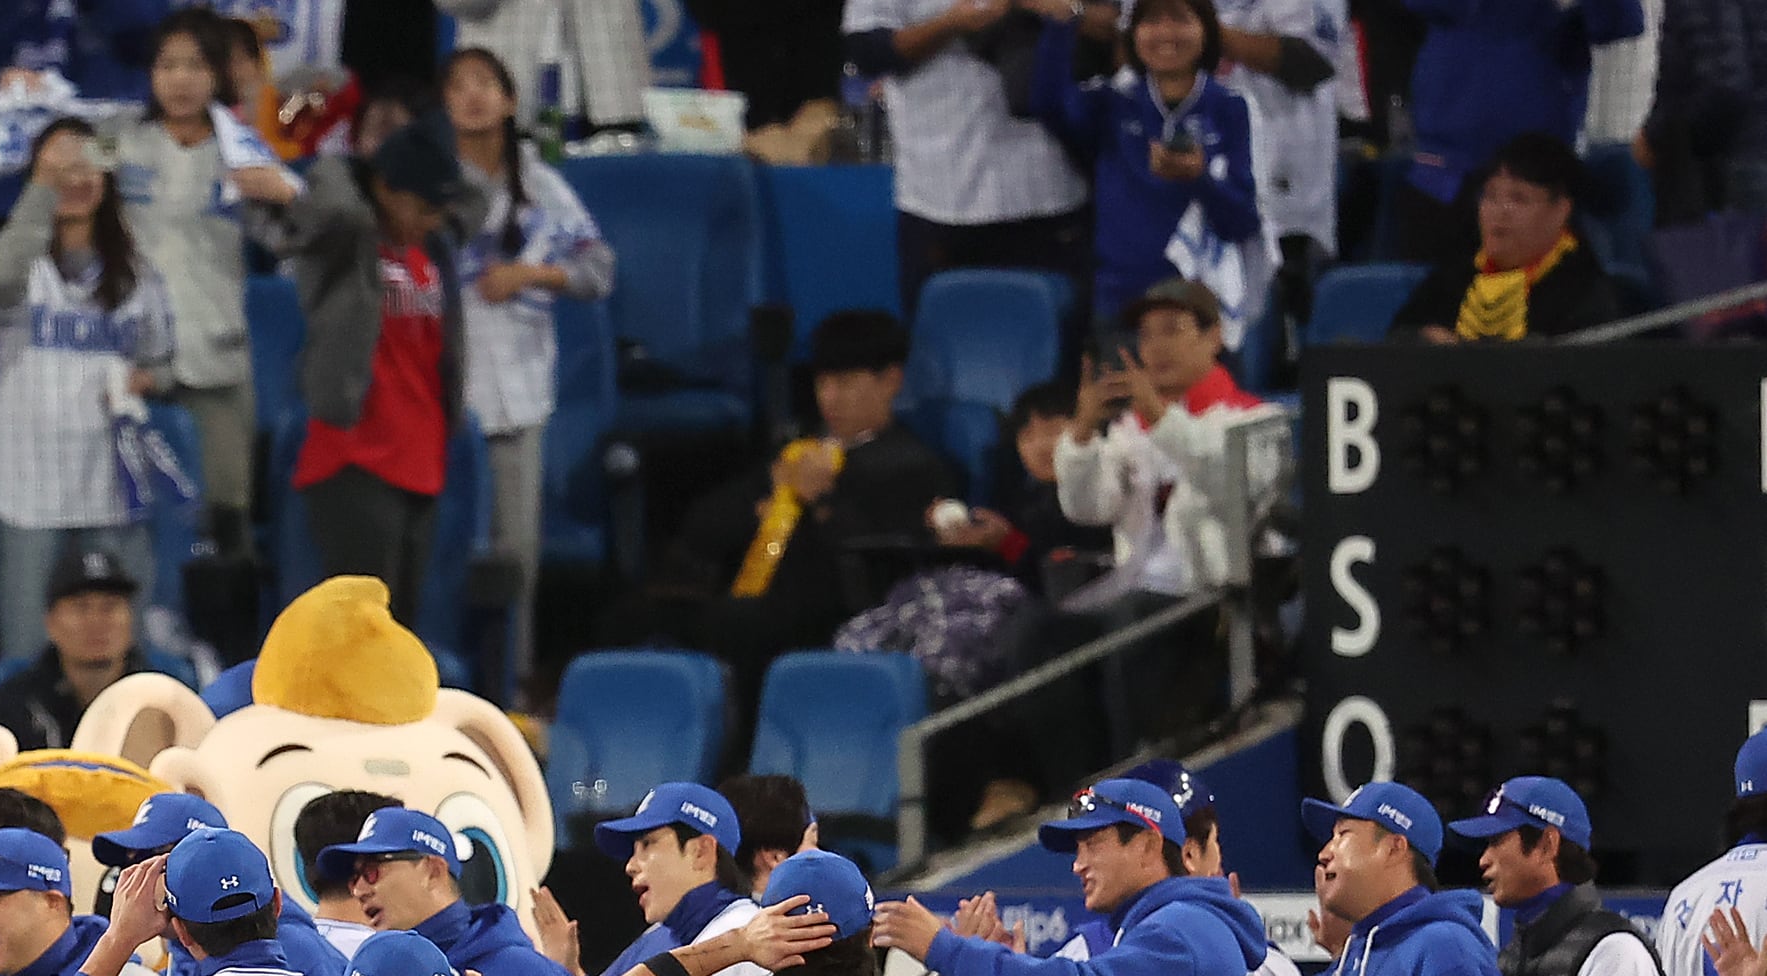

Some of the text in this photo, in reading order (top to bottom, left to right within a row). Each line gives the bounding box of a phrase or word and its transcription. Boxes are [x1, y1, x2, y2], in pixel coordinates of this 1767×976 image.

[1326, 376, 1381, 495] B
[1329, 535, 1382, 658] S
[1323, 695, 1396, 806] O
